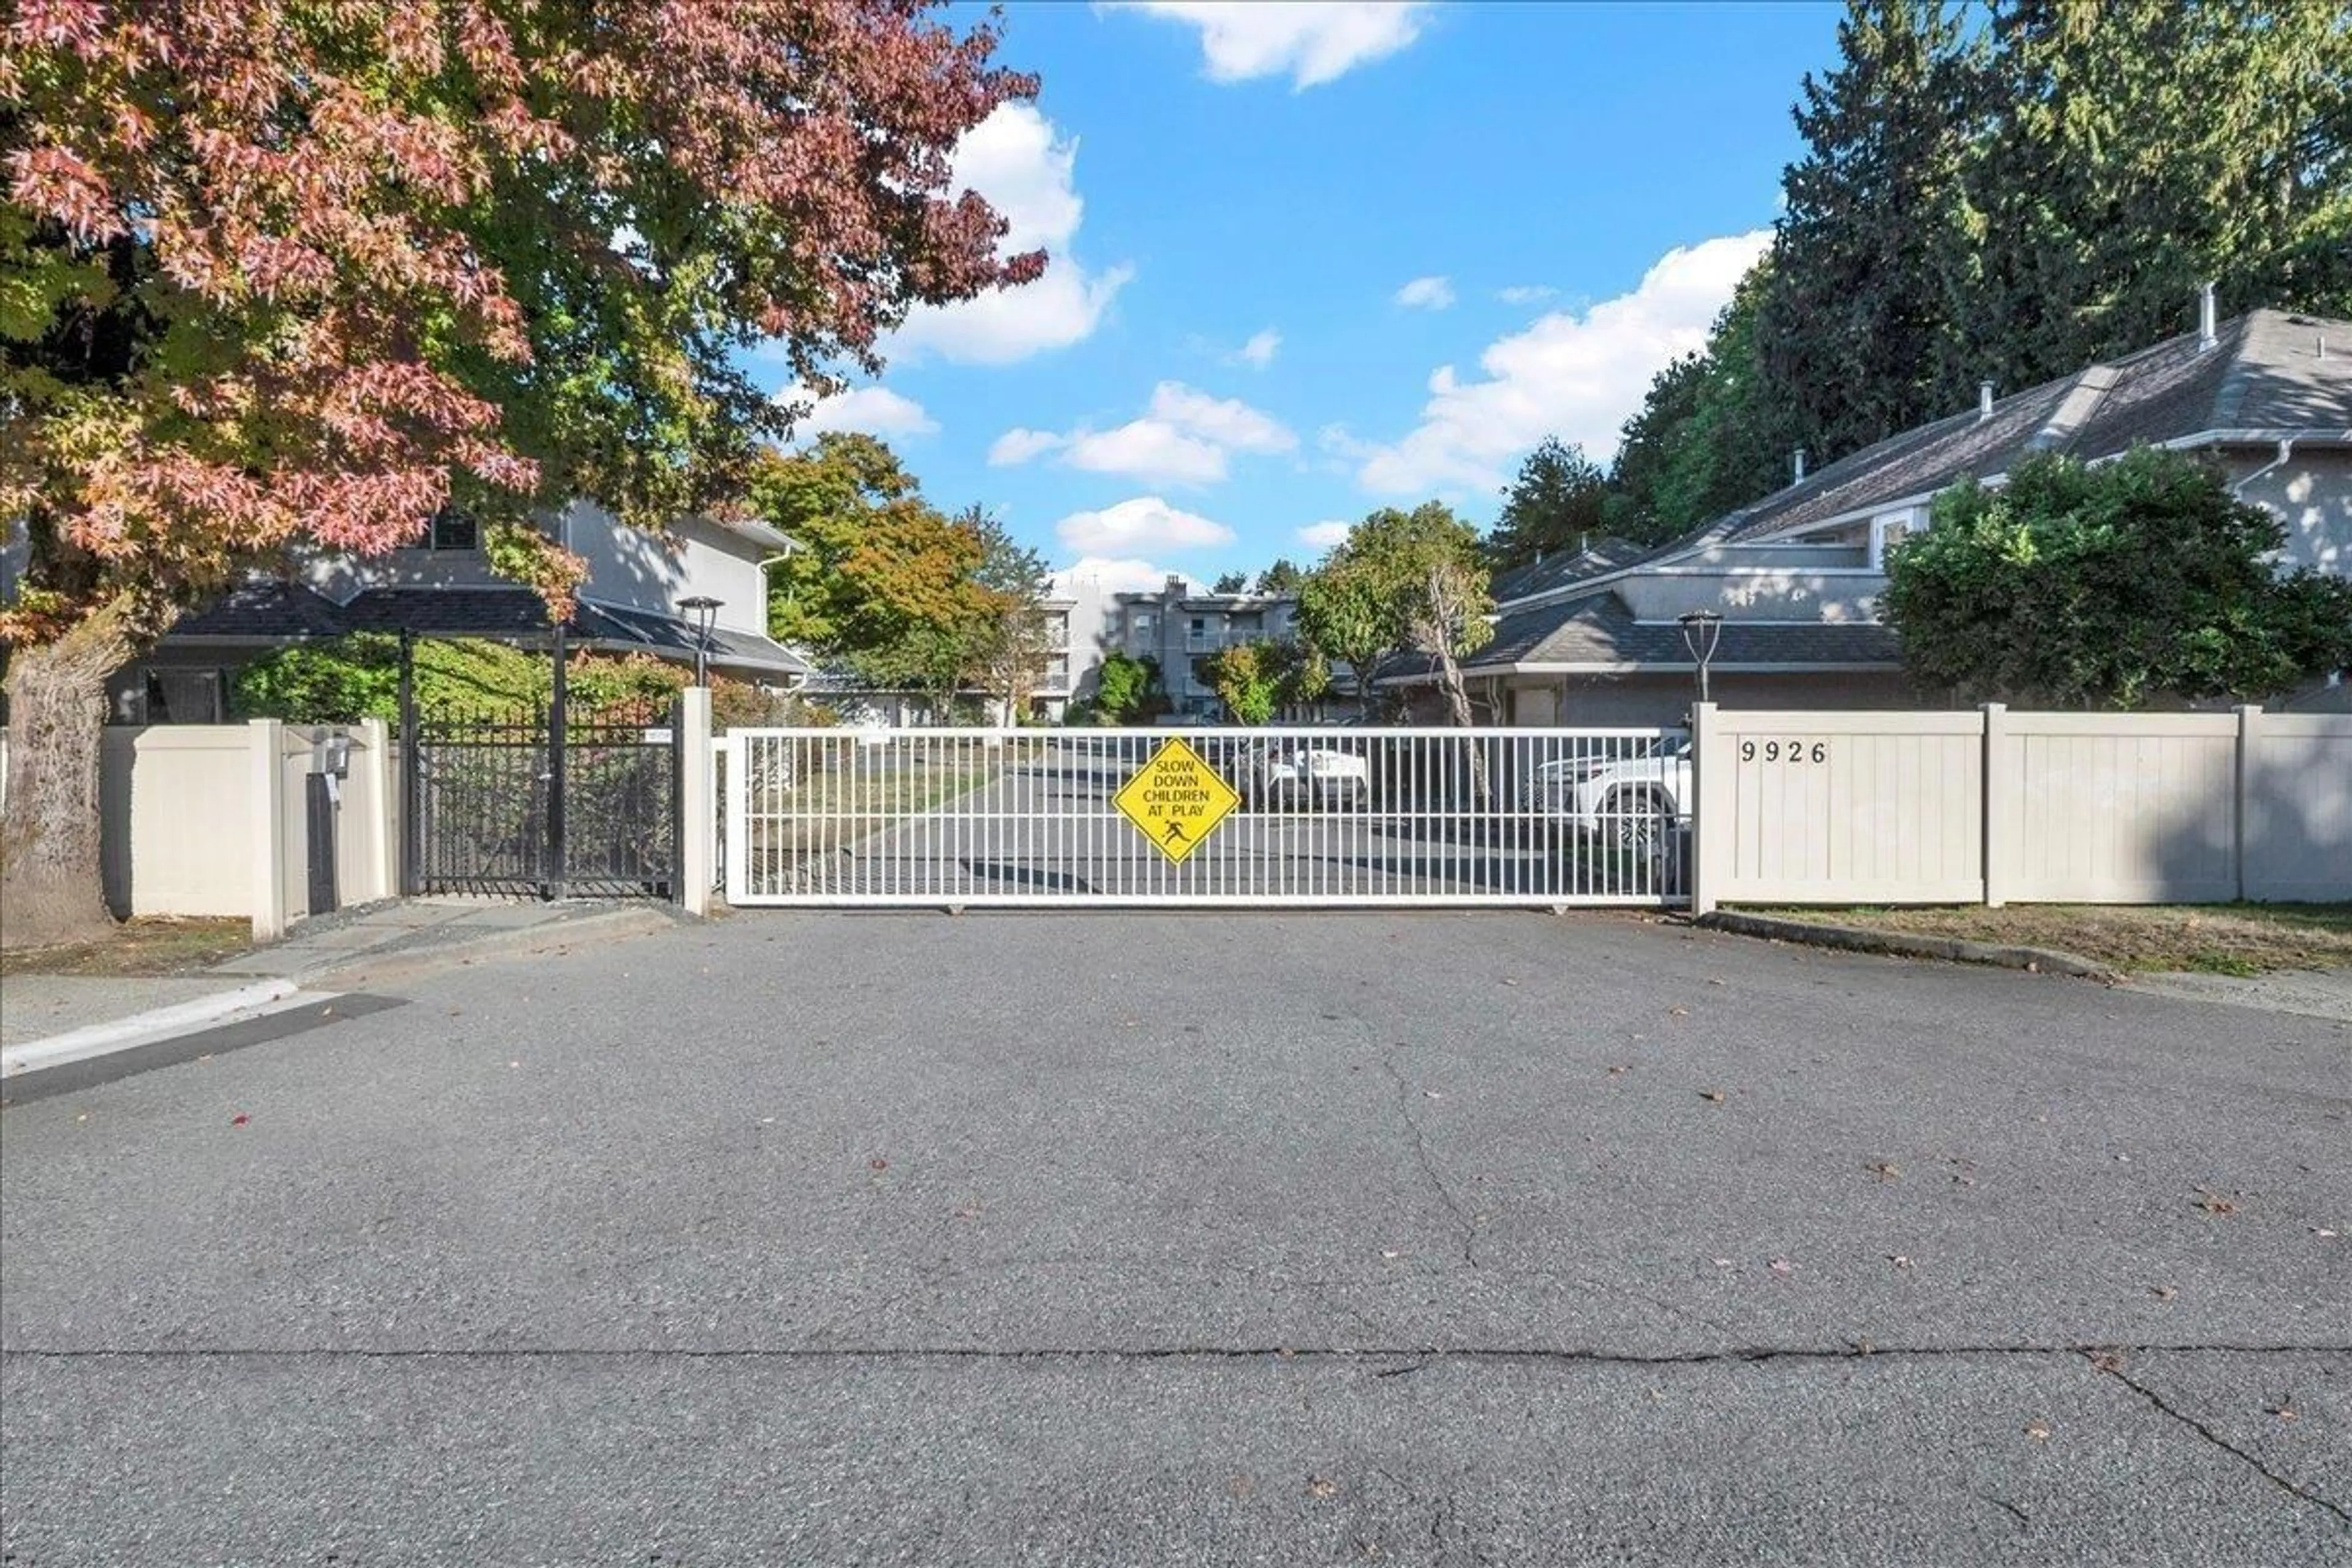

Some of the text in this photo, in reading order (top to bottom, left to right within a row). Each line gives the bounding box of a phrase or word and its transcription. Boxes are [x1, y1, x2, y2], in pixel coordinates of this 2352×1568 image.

[1742, 741, 1825, 763] 9926
[1156, 760, 1194, 772] SLOW
[1154, 775, 1198, 787] DOWN
[1143, 790, 1210, 802] CHILDREN
[1148, 804, 1204, 816] AT PLAY
